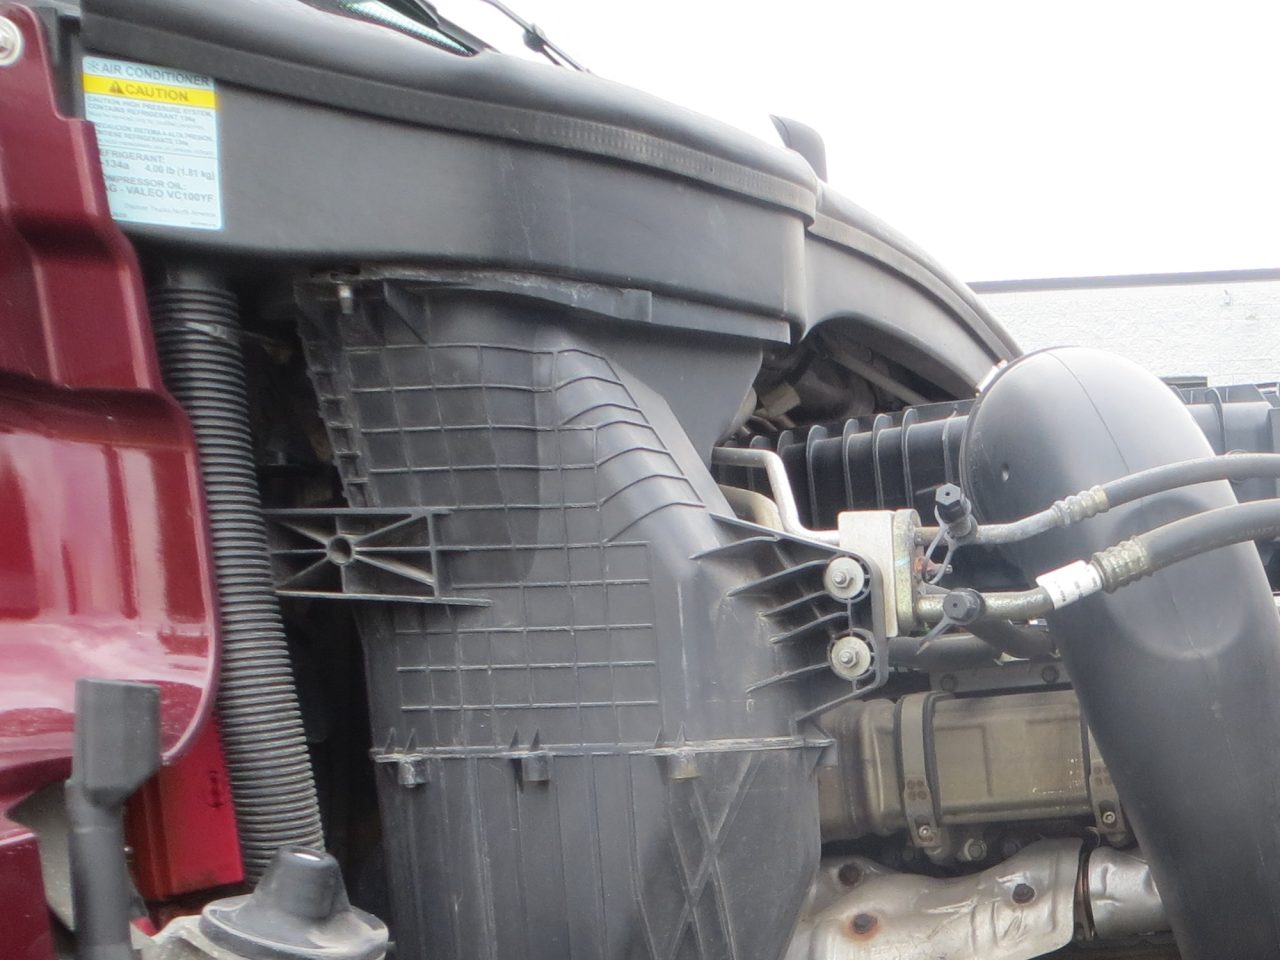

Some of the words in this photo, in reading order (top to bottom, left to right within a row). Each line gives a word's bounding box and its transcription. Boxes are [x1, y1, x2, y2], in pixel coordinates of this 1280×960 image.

[102, 63, 121, 75] AIR
[127, 65, 210, 87] CONDITIONER
[126, 83, 189, 102] CAUTION
[102, 150, 165, 164] EFRIGERANT:
[102, 159, 130, 170] -134a
[126, 185, 164, 198] VALEO
